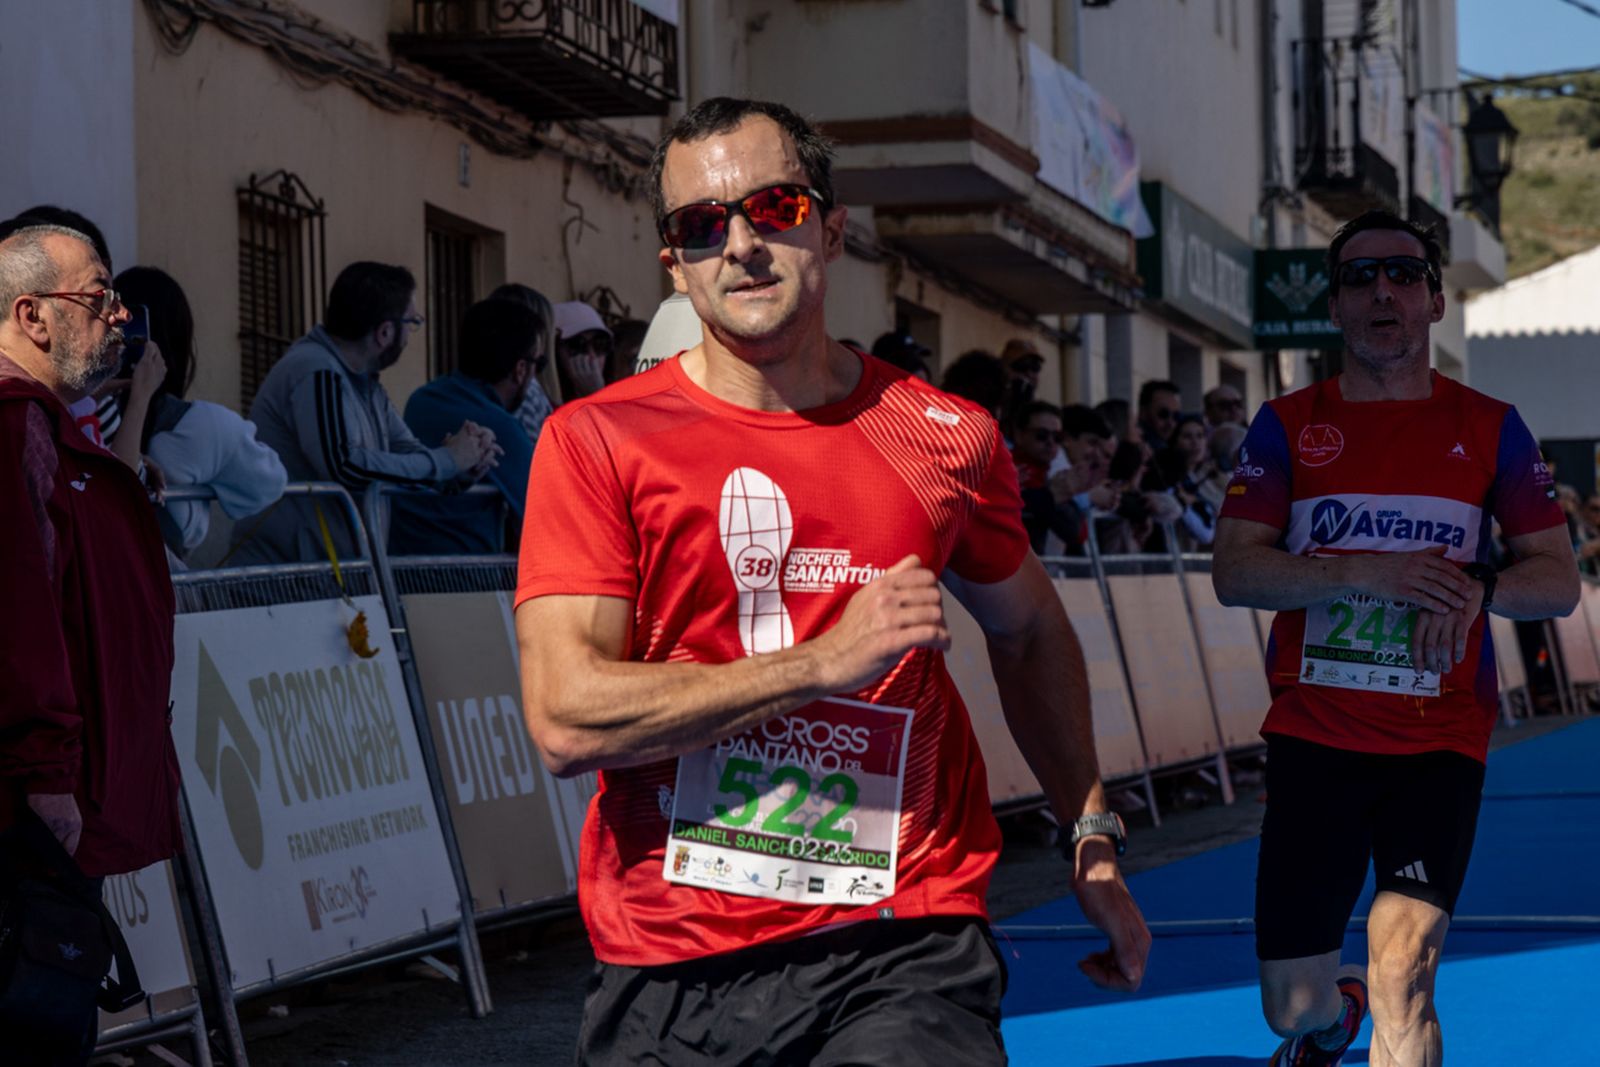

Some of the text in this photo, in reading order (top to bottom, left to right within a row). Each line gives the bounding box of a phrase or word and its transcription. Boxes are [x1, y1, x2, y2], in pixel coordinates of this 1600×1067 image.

[1351, 511, 1466, 548] Avanza
[1376, 510, 1402, 518] GRUPO
[740, 558, 773, 577] 38
[783, 563, 885, 585] SAN ANTÓN
[788, 552, 851, 567] NOCHE DE
[1326, 601, 1416, 653] 244
[249, 660, 410, 807] TECNOCASA
[762, 715, 870, 754] CROSS
[715, 736, 863, 774] PANTANO DEL
[714, 757, 859, 843] 522
[287, 804, 428, 862] FRANCHISING NETWORK
[674, 822, 731, 847] DANIEL
